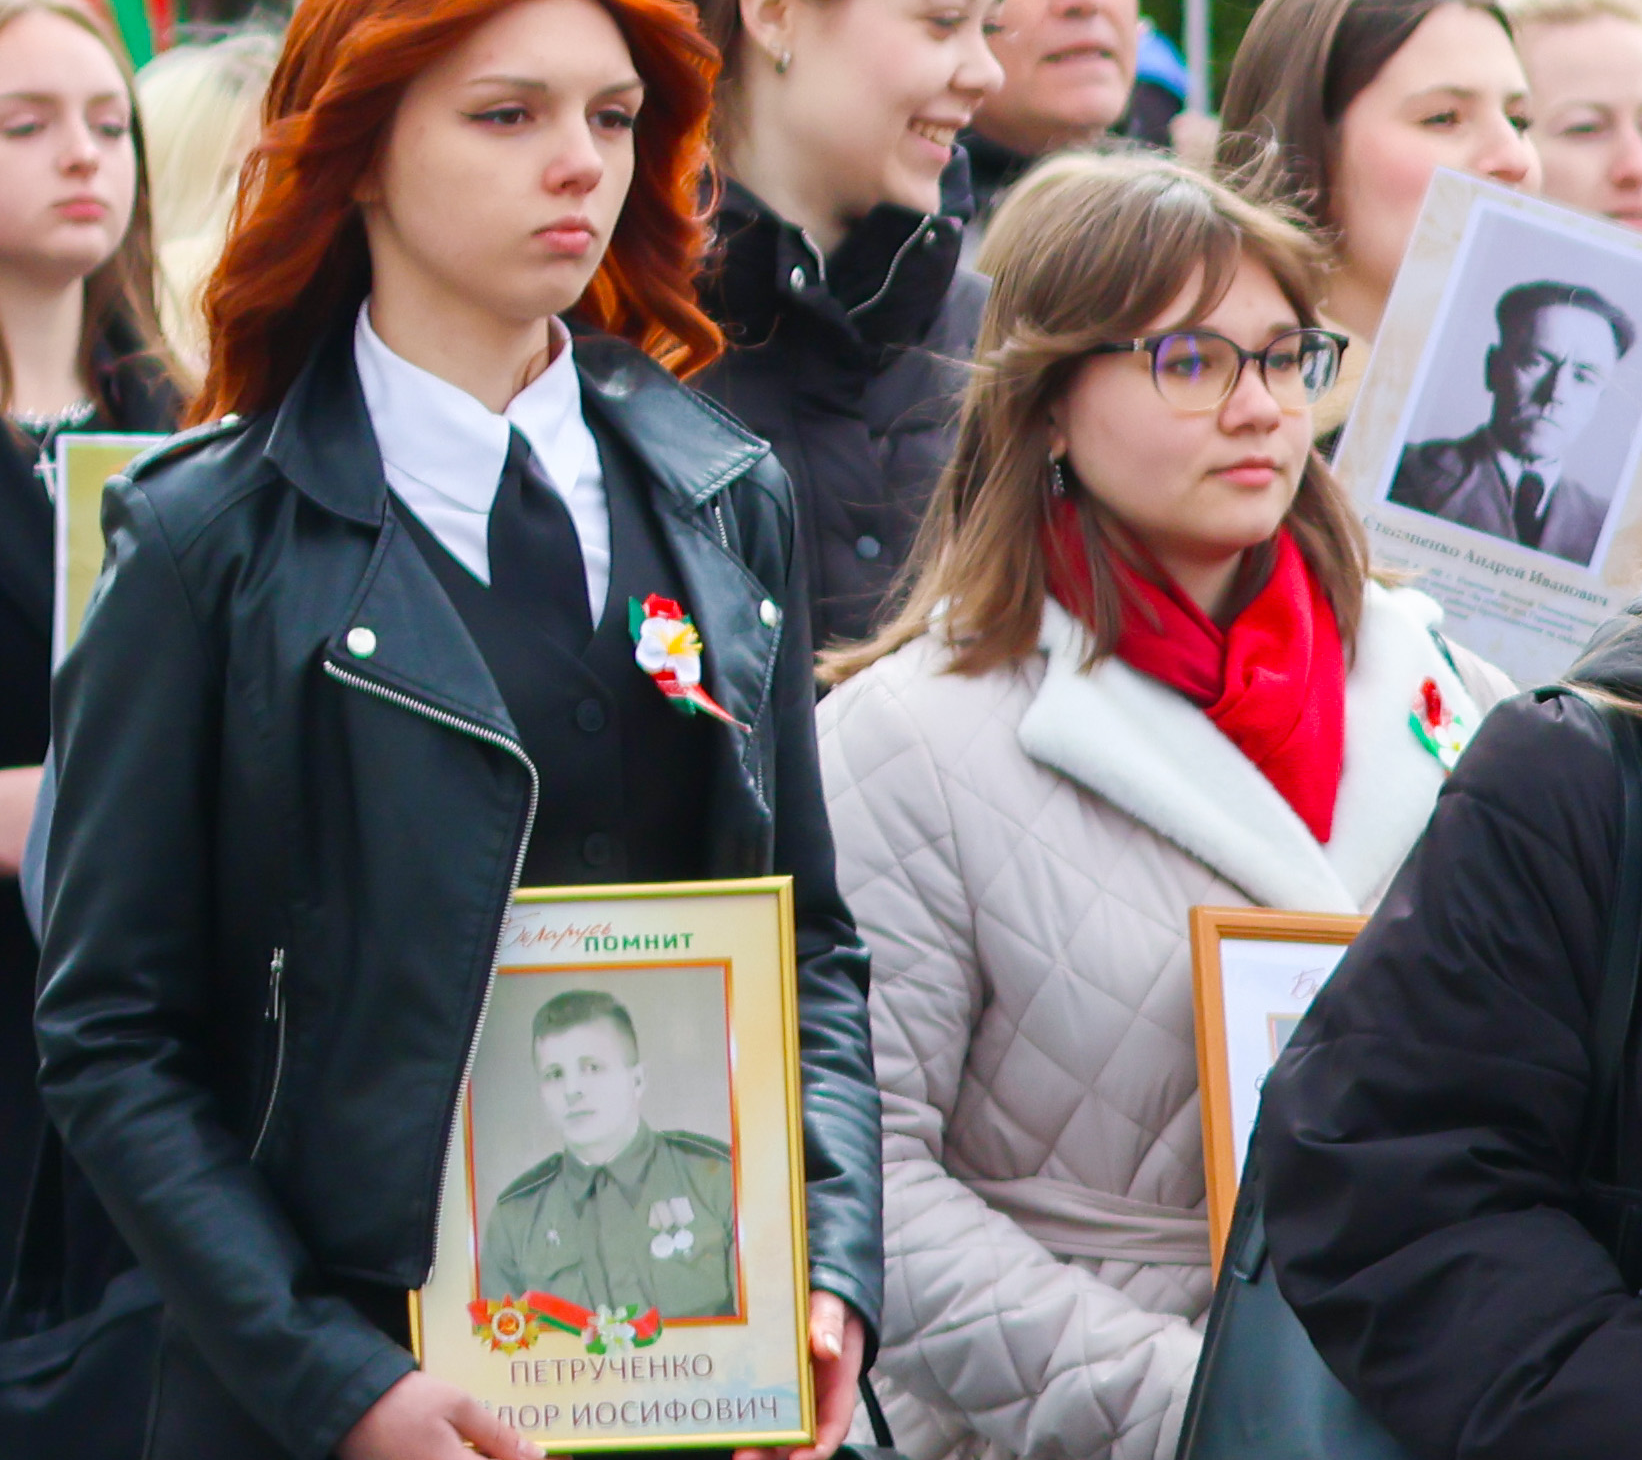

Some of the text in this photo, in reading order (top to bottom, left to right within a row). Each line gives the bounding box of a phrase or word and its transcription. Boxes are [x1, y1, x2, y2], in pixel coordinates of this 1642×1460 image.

[1464, 549, 1526, 580] Андрей
[1529, 570, 1609, 607] Иванович
[584, 933, 694, 952] ПОМНИТ
[509, 1353, 714, 1385] ПЕТРУЧЕНКО
[478, 1395, 779, 1430] ДОР ИОСИФОВИЧ
